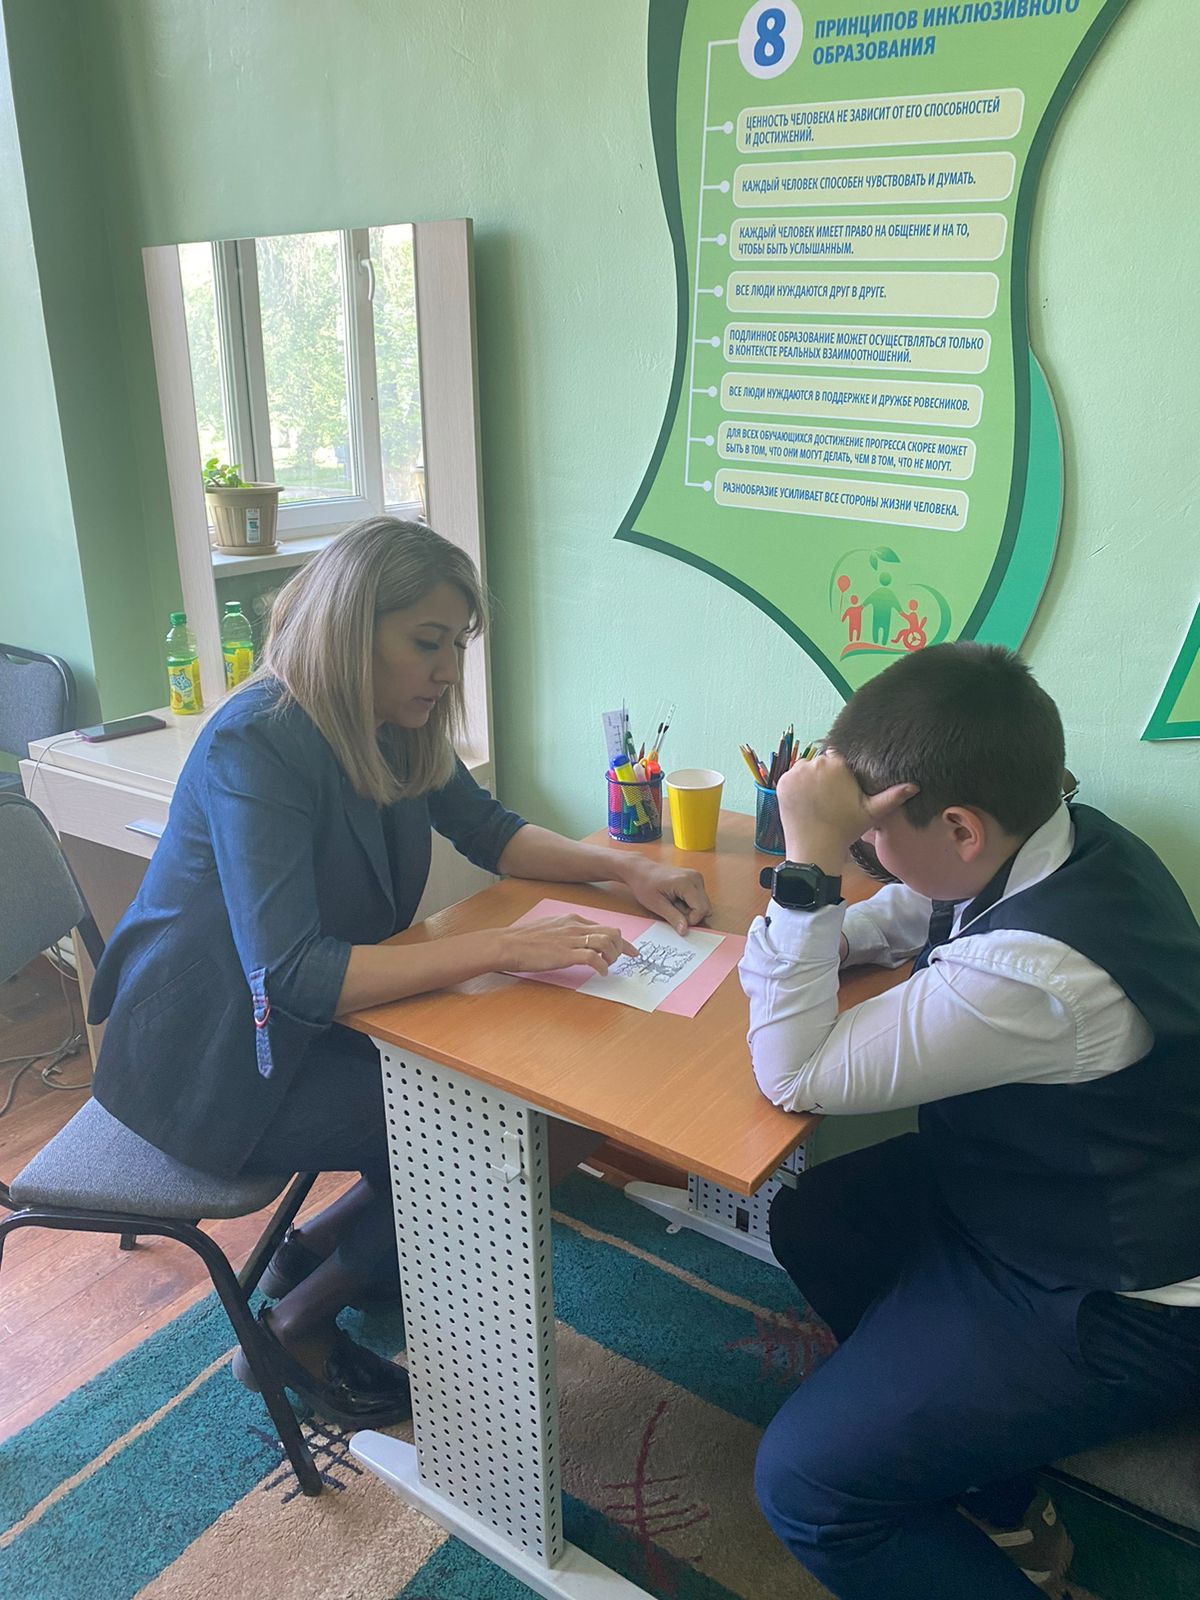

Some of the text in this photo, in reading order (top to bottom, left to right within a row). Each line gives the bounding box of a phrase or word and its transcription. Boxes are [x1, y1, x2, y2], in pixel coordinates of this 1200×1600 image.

[814, 0, 1080, 39] ПРИНЦИПОВ ИНКЛЮЗИВНОГО
[753, 8, 786, 67] 8
[812, 35, 936, 66] ОБРАЗОВАНИЯ
[745, 97, 1001, 131] ЦЕННОСТЬ ЧЕЛОВЕКА НЕ ЗАВИСИТ ОТ ЕГО СПОСОБНОСТЕЙ
[745, 126, 814, 146] И ДОСТИЖЕНИЙ.
[742, 172, 976, 193] КАЖДЫЙ ЧЕЛОВЕК СПОСОБЕН ЧУВСТВОВАТЬ И ДУМАТЬ.
[739, 224, 969, 242] КАЖДЫЙ ЧЕЛОВЕК ИМЕЕТ ПРАВО НА ОБЩЕНИЕ И НА ТО,
[738, 242, 854, 255] ЧТОБЫ БЫТЬ УСЛЫШАННЫМ.
[735, 284, 886, 300] ВСЕ ЛЮДИ НУЖДАЮТСЯ ДРУГ В ДРУГЕ.
[729, 329, 984, 349] ПОДЛИННОЕ ОБРАЗОВАНИЕ МОЖЕТ ОСУЩЕСТВЛЯТЬСЯ ТОЛЬКО
[728, 344, 911, 363] В КОНТЕКСТЕ РЕАЛЬНЫХ ВЗАИМООТНОШЕНИЙ.
[728, 385, 970, 411] ВСЕ ЛЮДИ НУЖДАЮТСЯ В ПОДДЕРЖКЕ И ДРУЖБЕ РОВЕСНИКОВ.
[726, 427, 968, 456] ДЛЯ ВСЕХ ОБУЧАЮЩИХСЯ ДОСТИЖЕНИЕ ПРОГРЕССА СКОРЕЕ МОЖЕТ
[725, 443, 952, 472] БЫТЬ В ТОМ, ЧТО ОНИ МОГУТ ДЕЛАТЬ, ЧЕМ В ТОМ, ЧТО НЕ МОГУТ.
[722, 481, 959, 517] РАЗНООБРАЗИЕ УСИЛИВАЕТ ВСЕ СТОРОНЫ ЖИЗНИ ЧЕЛОВЕКА.
